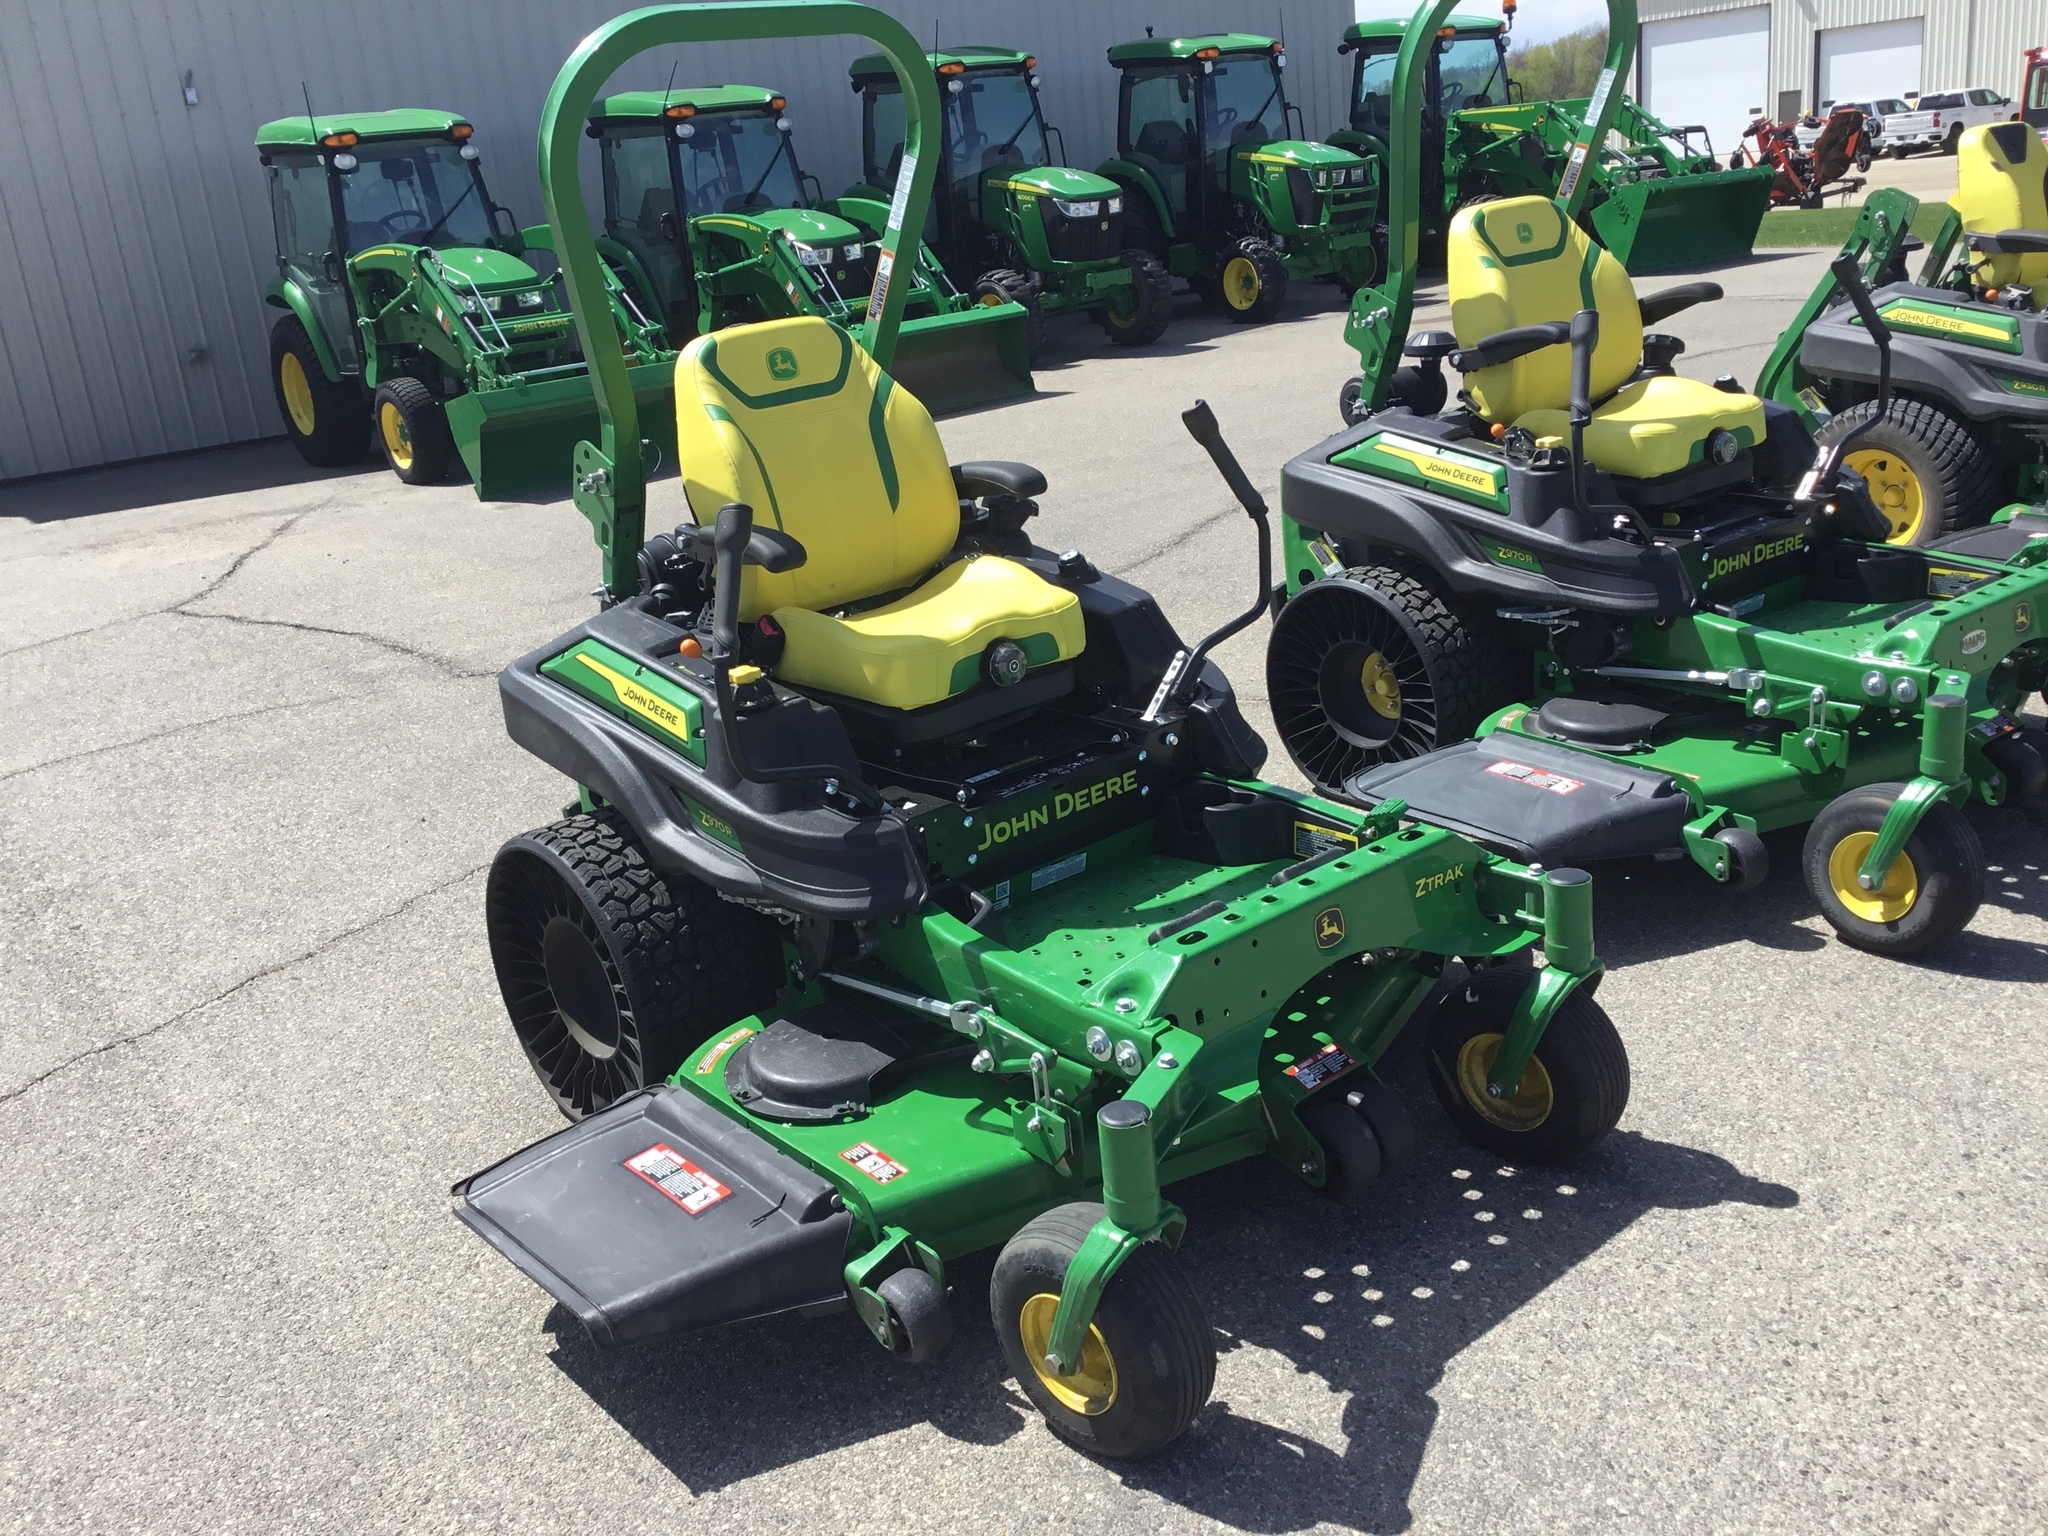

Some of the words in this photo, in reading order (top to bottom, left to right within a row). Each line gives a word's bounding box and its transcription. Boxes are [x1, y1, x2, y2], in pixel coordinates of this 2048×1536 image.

[513, 322, 538, 333] JOHN
[538, 318, 570, 329] DEERE
[1892, 310, 1925, 325] JOHN
[1926, 315, 1965, 331] DEERE
[1425, 462, 1452, 476] JOHN
[1452, 469, 1486, 486] DEERE
[1497, 546, 1534, 564] Z970R
[1708, 551, 1751, 579] JOHN
[1754, 533, 1804, 564] DEERE
[623, 686, 648, 707] JOHN
[647, 699, 679, 726] DEERE
[699, 810, 733, 838] Z970R
[978, 804, 1049, 851] JOHN
[1054, 769, 1138, 820] DEERE
[1415, 863, 1464, 899] ZTRAK
